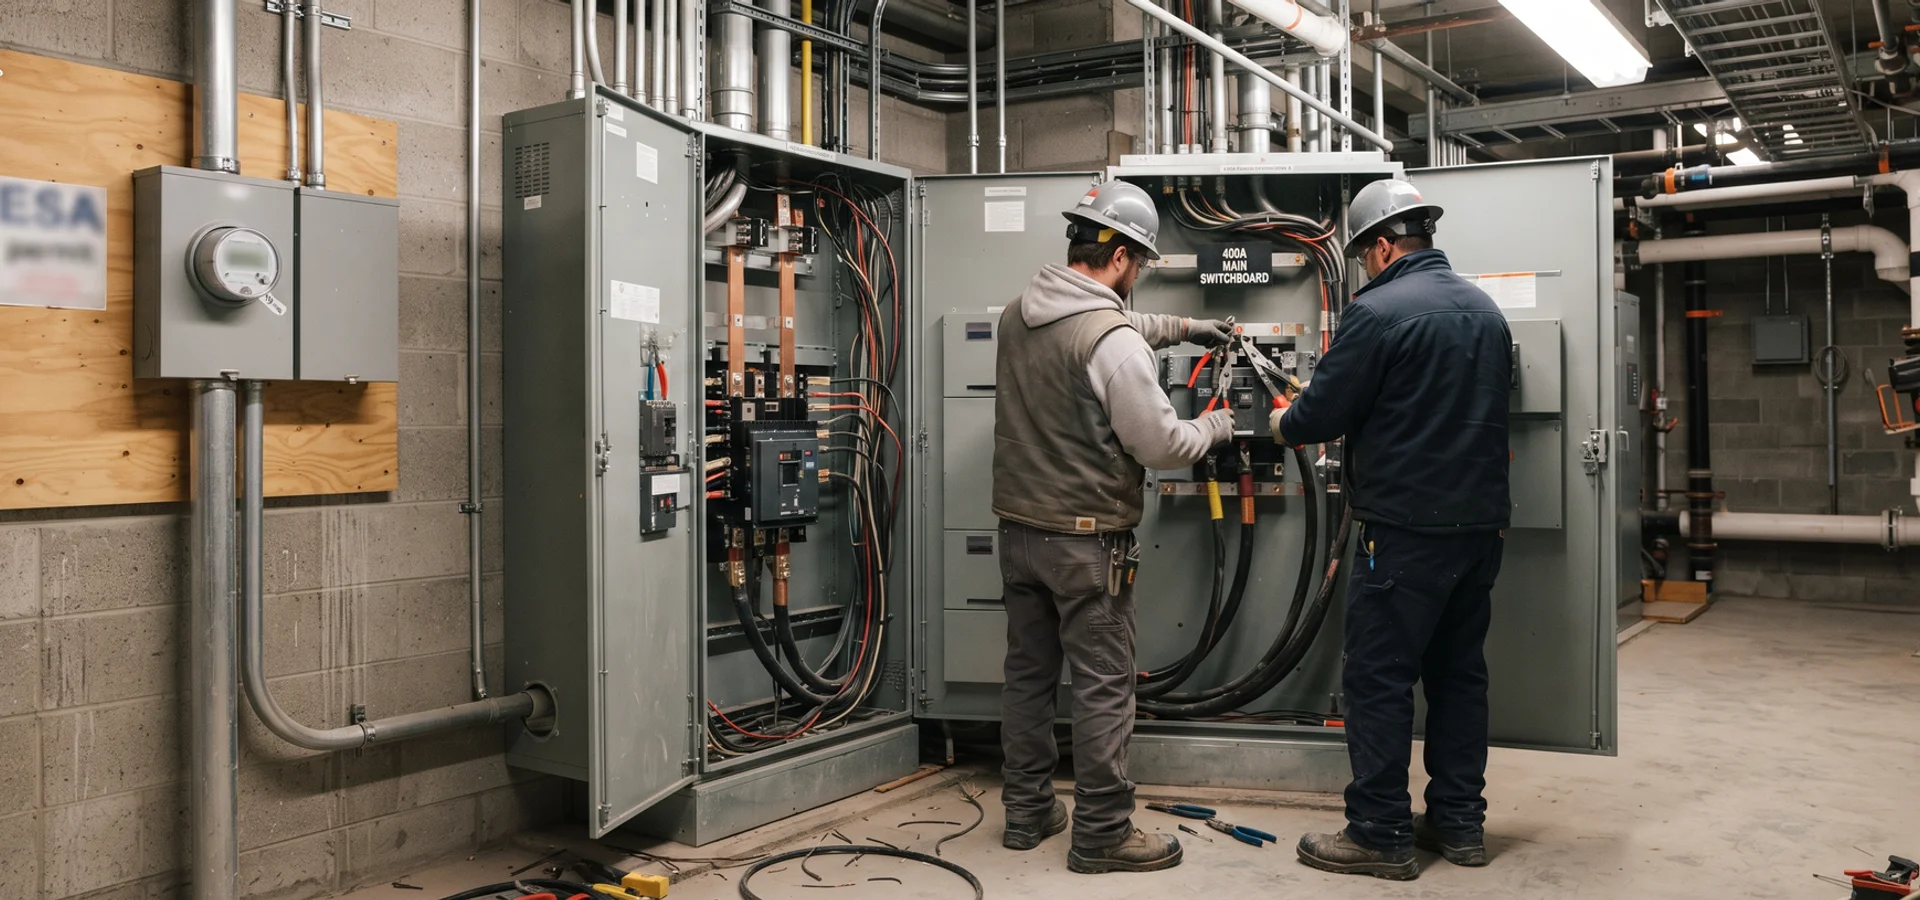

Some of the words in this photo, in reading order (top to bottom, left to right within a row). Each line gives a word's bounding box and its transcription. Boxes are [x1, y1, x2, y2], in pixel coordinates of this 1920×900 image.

[1, 184, 103, 233] ESA
[1222, 248, 1247, 259] 400A
[1222, 260, 1247, 271] MAIN
[1200, 272, 1269, 284] SWITCHBOARD
